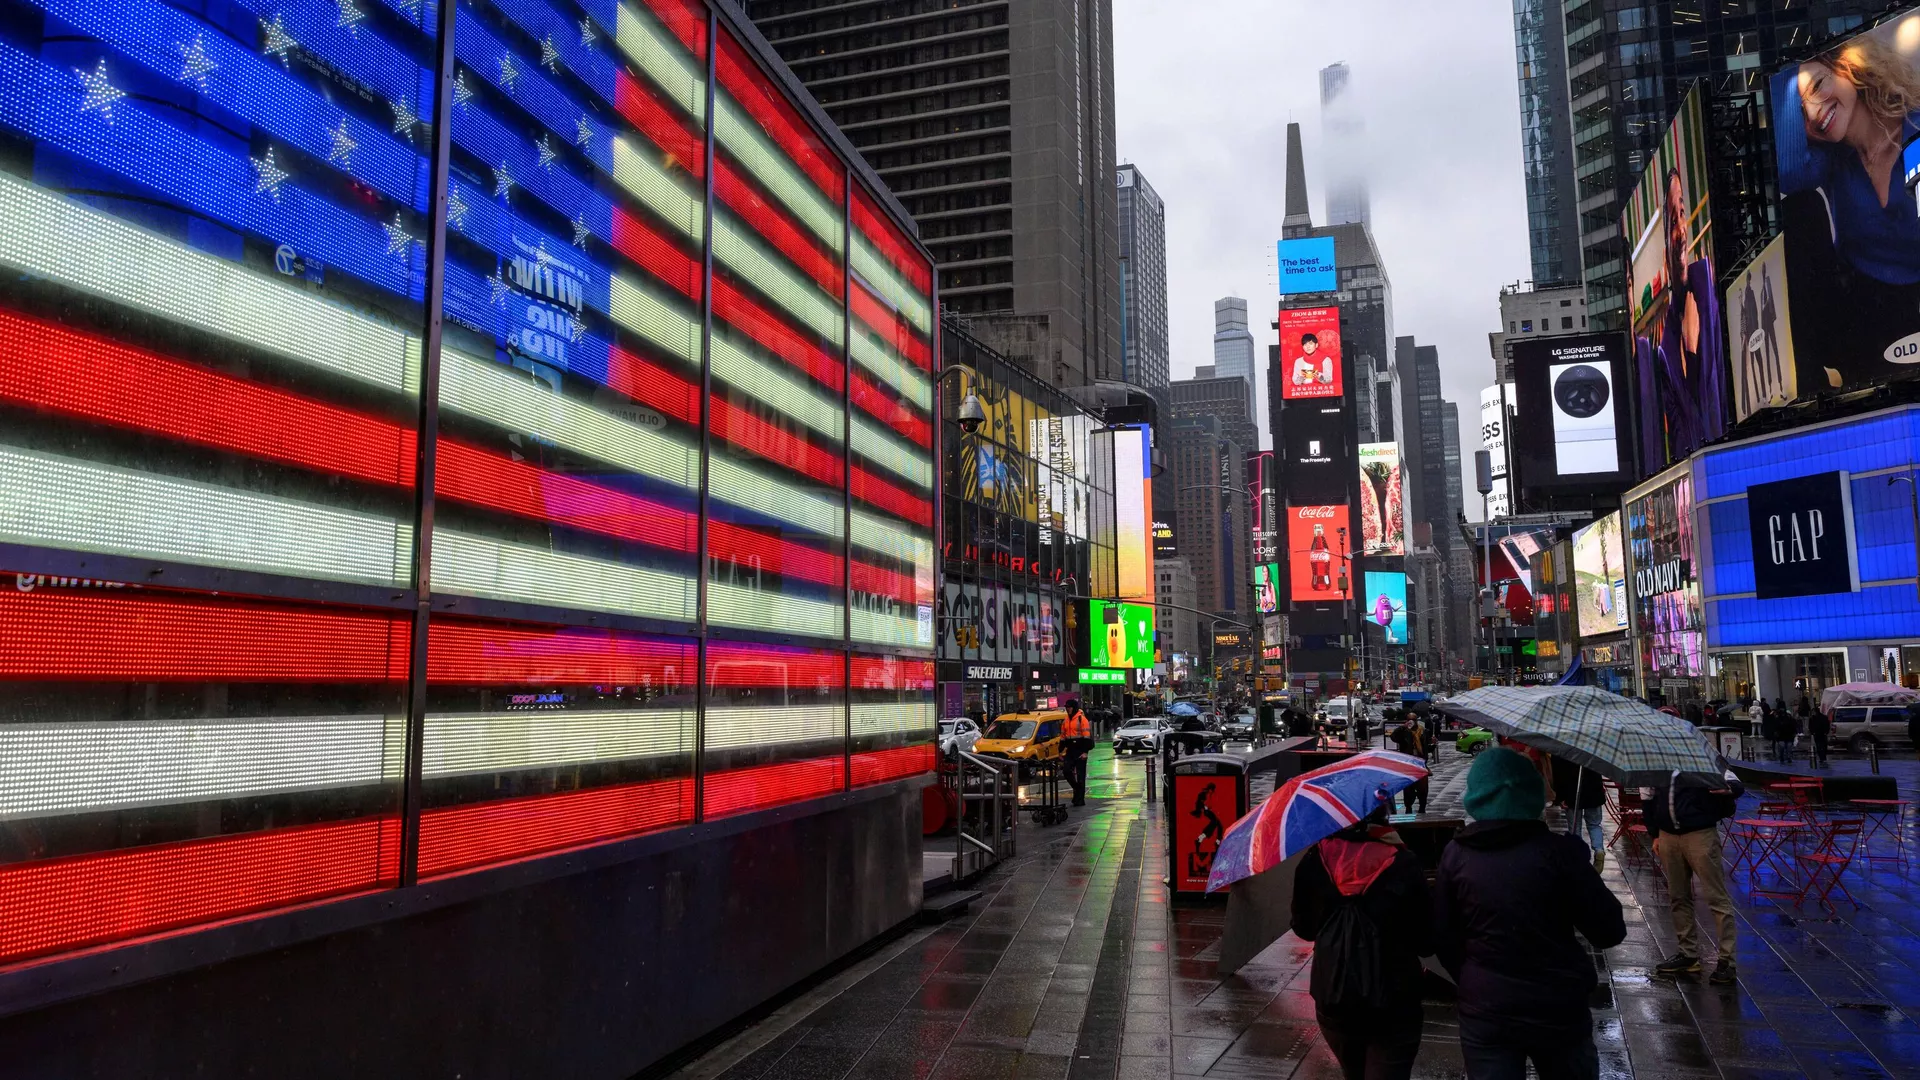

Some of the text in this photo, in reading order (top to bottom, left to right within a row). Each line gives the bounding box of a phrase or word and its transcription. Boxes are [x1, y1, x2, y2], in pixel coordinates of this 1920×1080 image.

[1319, 264, 1335, 272] ask
[1563, 346, 1605, 354] SIGNATURE
[1894, 342, 1917, 358] OLD
[1361, 448, 1396, 456] freshdirect
[1769, 509, 1824, 565] GAP
[1637, 559, 1680, 598] OLD NAVY
[952, 593, 997, 649] CBS
[1003, 600, 1060, 653] NEWS
[1137, 639, 1149, 653] NYC
[967, 666, 1012, 679] SKECHERS
